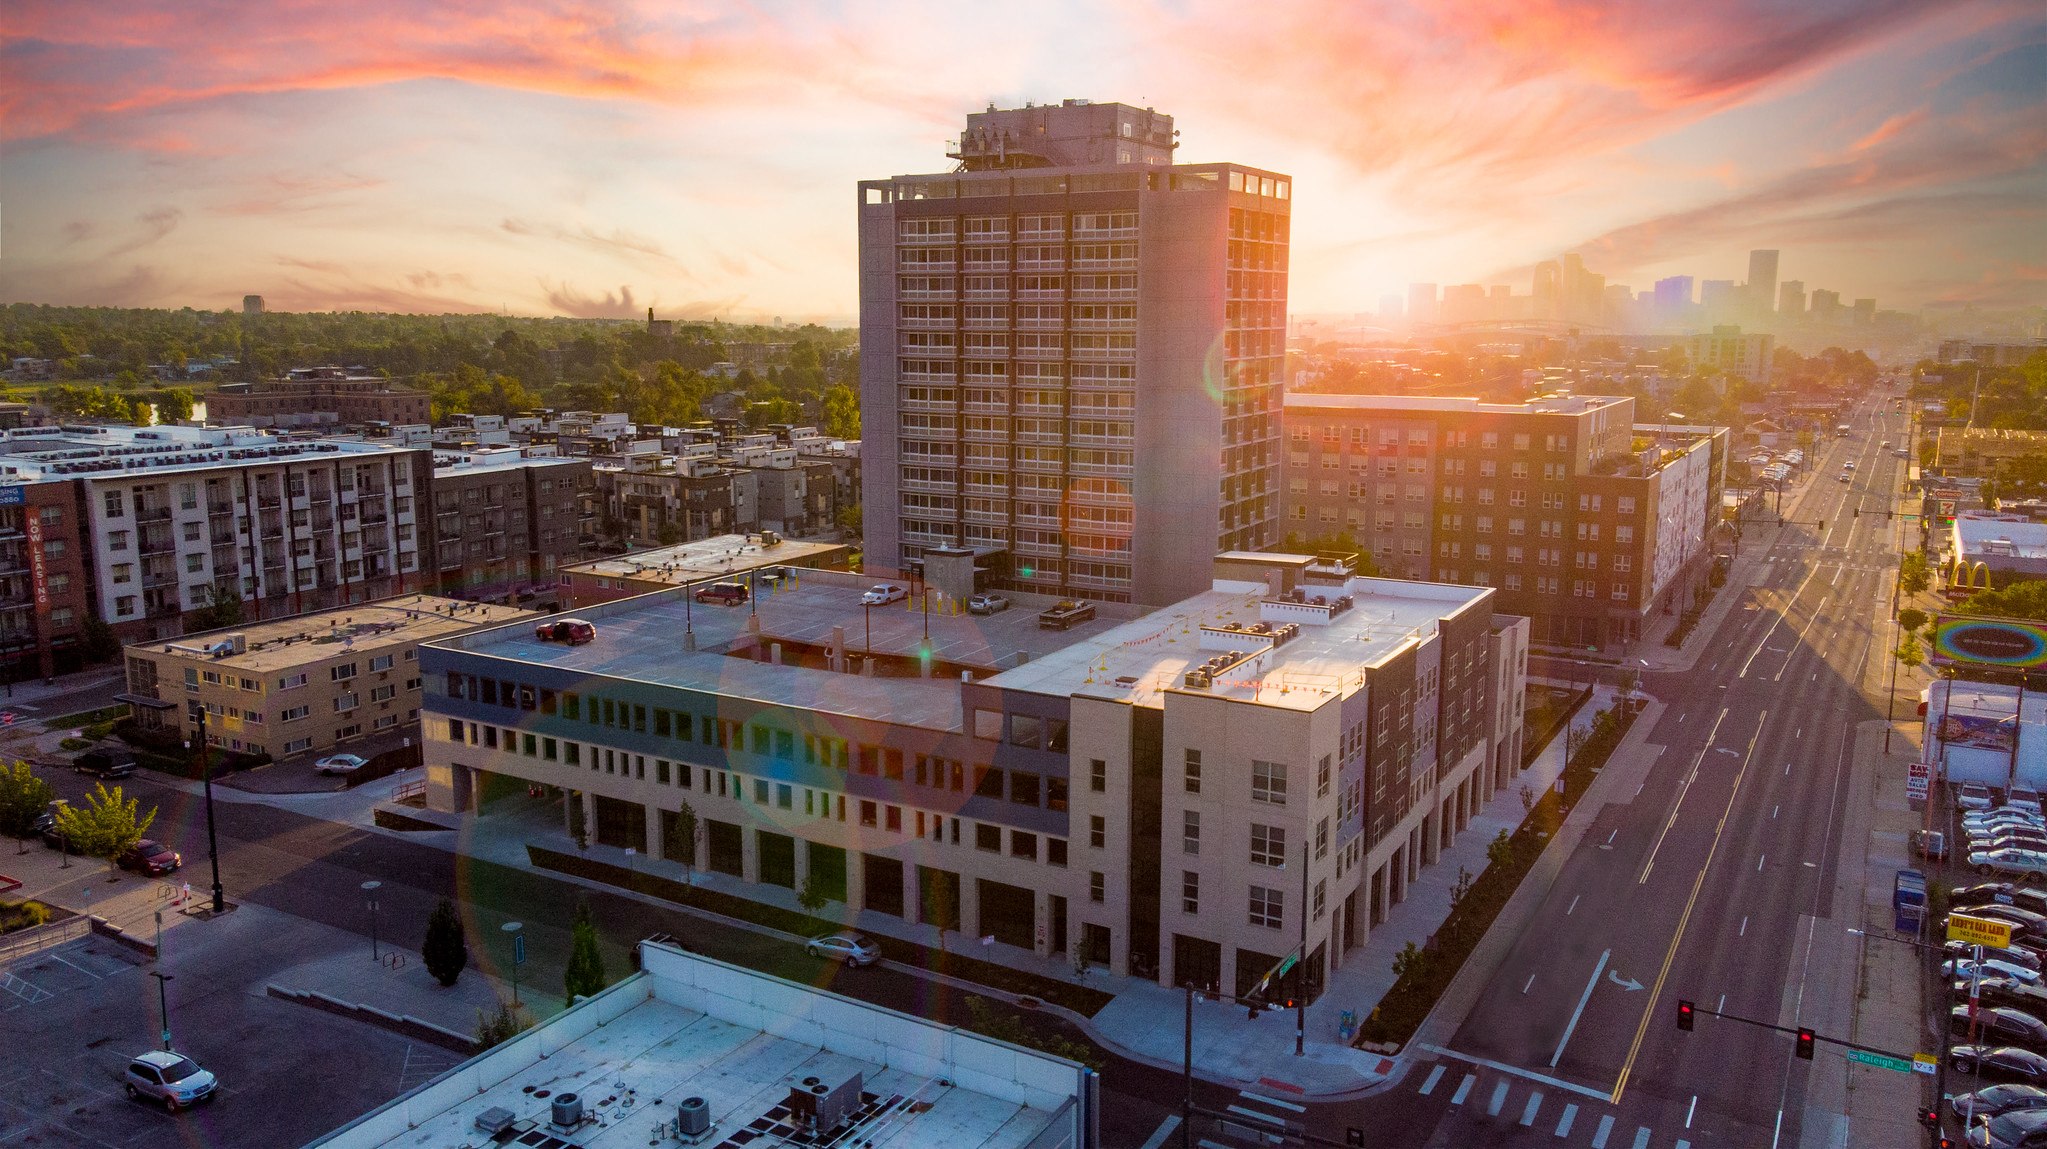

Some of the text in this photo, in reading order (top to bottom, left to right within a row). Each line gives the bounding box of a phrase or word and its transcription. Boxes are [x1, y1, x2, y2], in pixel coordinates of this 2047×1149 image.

[30, 518, 47, 603] NOW LEASING
[1859, 1054, 1894, 1068] Raleigh
